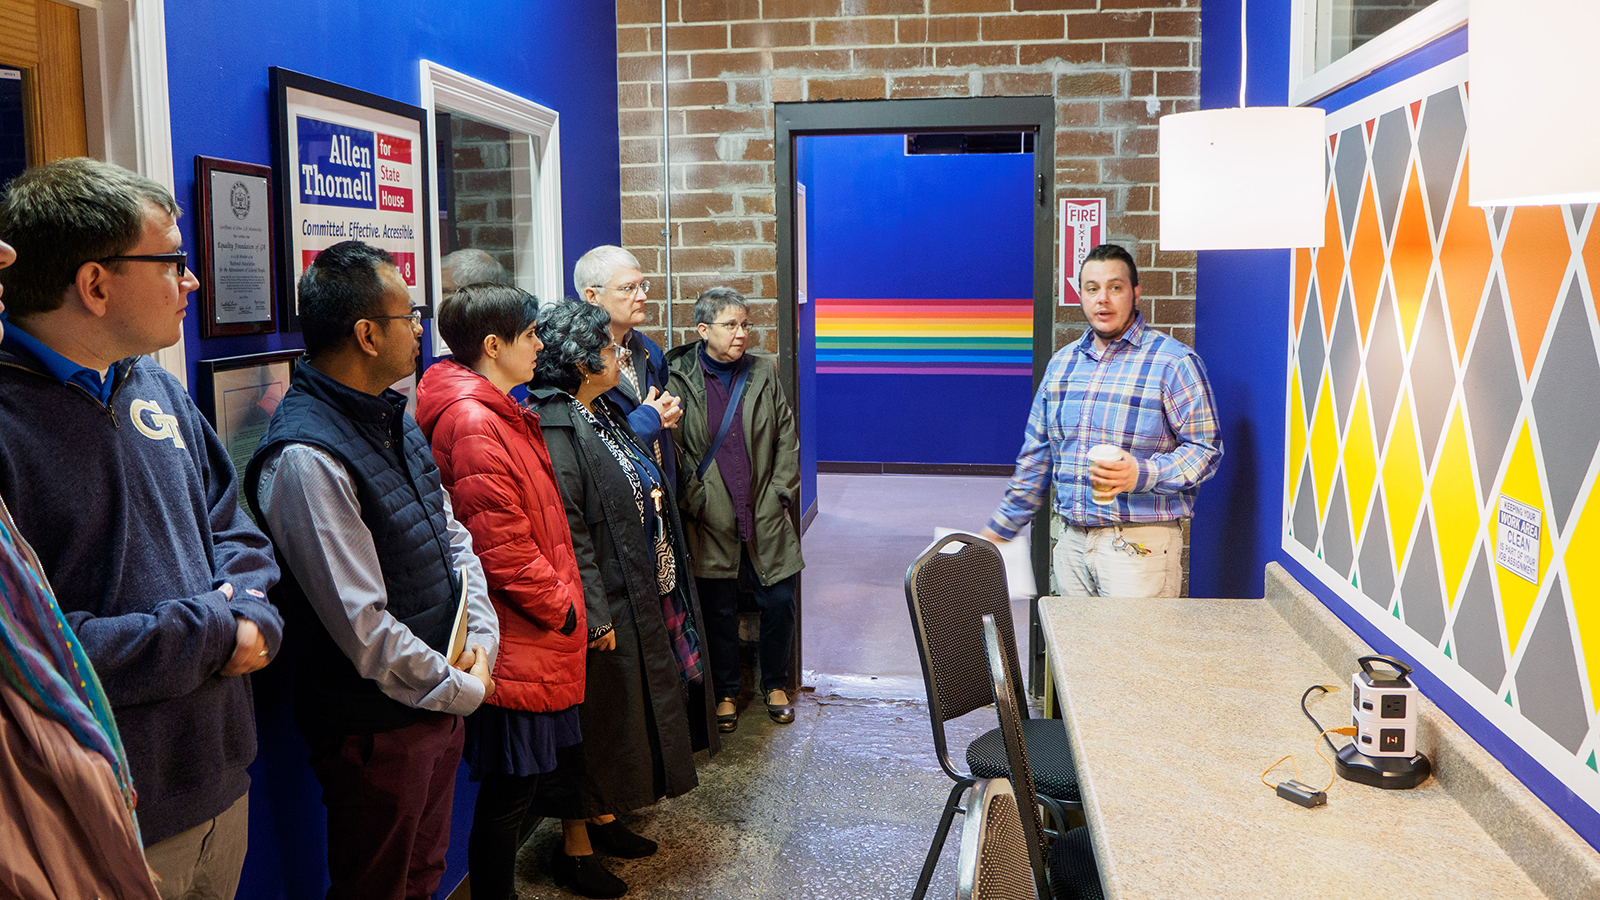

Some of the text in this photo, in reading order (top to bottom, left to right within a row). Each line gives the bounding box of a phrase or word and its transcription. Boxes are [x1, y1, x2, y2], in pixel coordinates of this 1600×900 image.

[329, 134, 371, 169] Allen
[380, 139, 392, 156] for
[302, 164, 373, 202] Thornell
[380, 165, 400, 182] State
[381, 190, 405, 208] House
[1070, 209, 1096, 222] FIRE
[302, 219, 415, 241] Committed. Effective. Accessible.
[217, 241, 234, 251] Equality
[404, 261, 411, 278] 8
[130, 398, 187, 450] GT
[1504, 502, 1537, 521] KEEPING YOUR
[1501, 511, 1539, 539] WORK AREA
[1507, 530, 1530, 553] CLEAN
[1498, 551, 1536, 578] JOB ASSIGNMENT
[1500, 542, 1536, 567] IS PART OF YOUR
